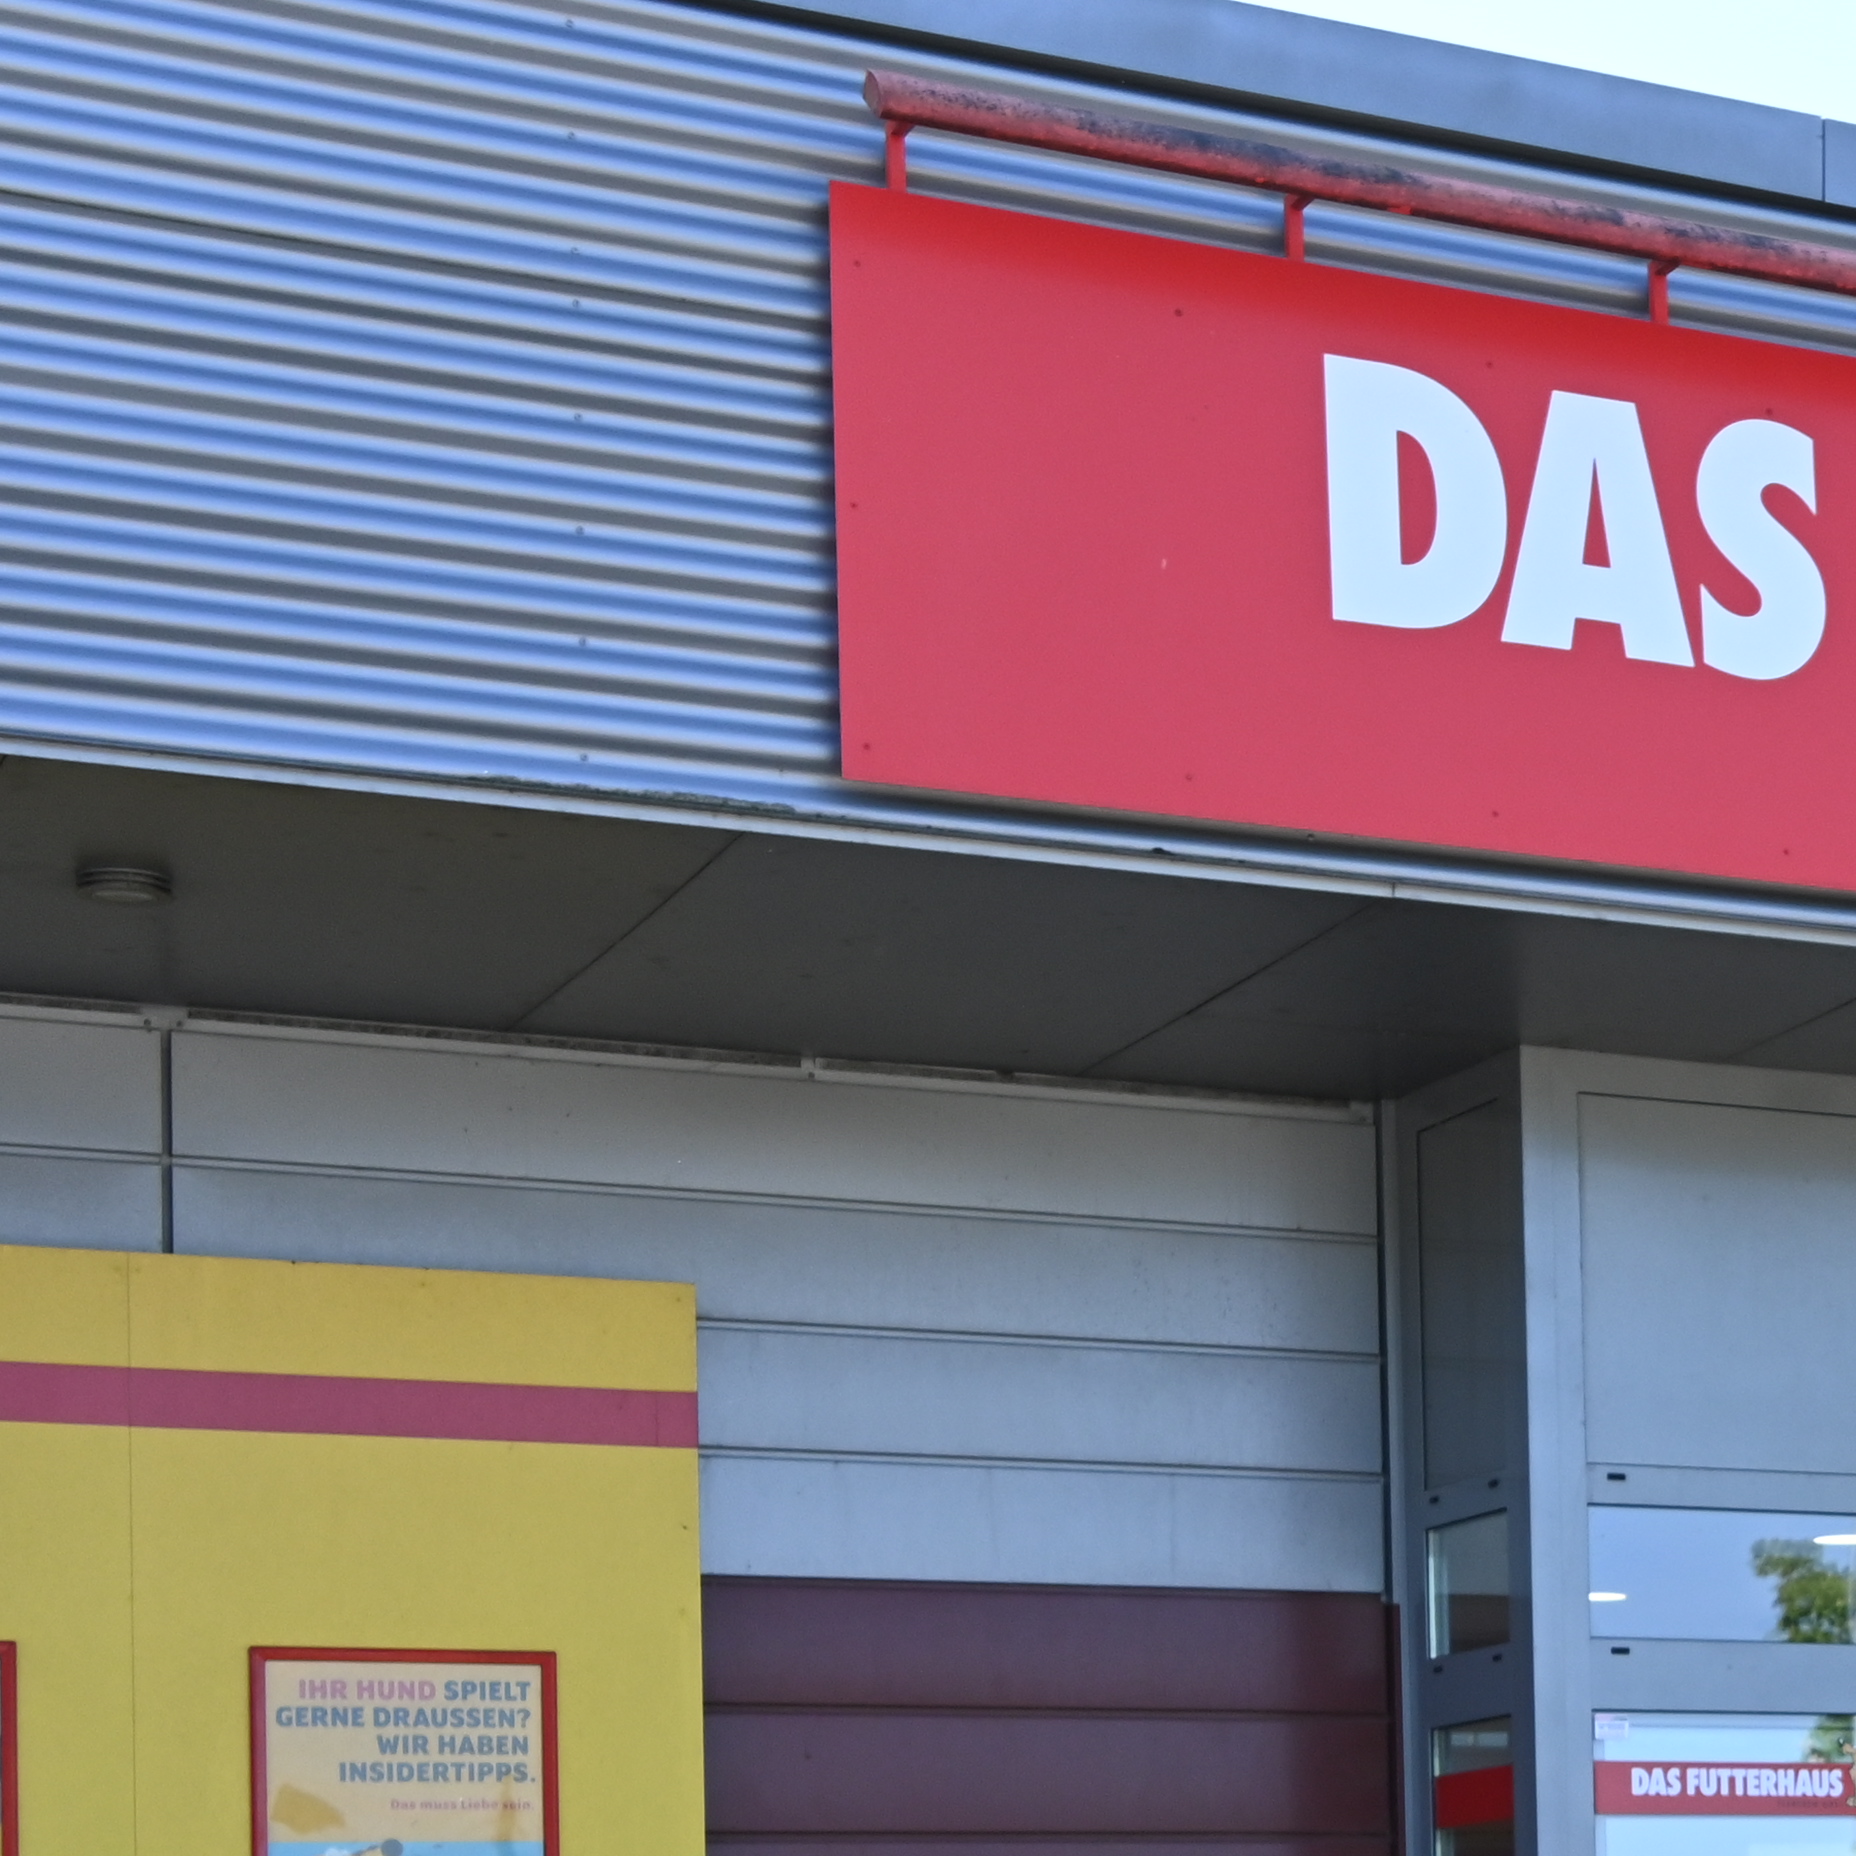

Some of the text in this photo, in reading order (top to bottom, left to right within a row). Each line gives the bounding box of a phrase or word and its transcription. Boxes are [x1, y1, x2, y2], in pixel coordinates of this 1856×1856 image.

[1324, 353, 1827, 680] DAS
[299, 1679, 531, 1701] IHR HUND SPIELT
[275, 1706, 531, 1729] GERNE DRAUSSEN?
[376, 1735, 530, 1756] WIR HABEN
[338, 1762, 537, 1783] INSIDERTIPPS.
[1631, 1767, 1844, 1798] DAS FUTTERHAUS
[390, 1799, 416, 1811] Das
[420, 1801, 457, 1811] muss
[461, 1799, 499, 1811] Liebe
